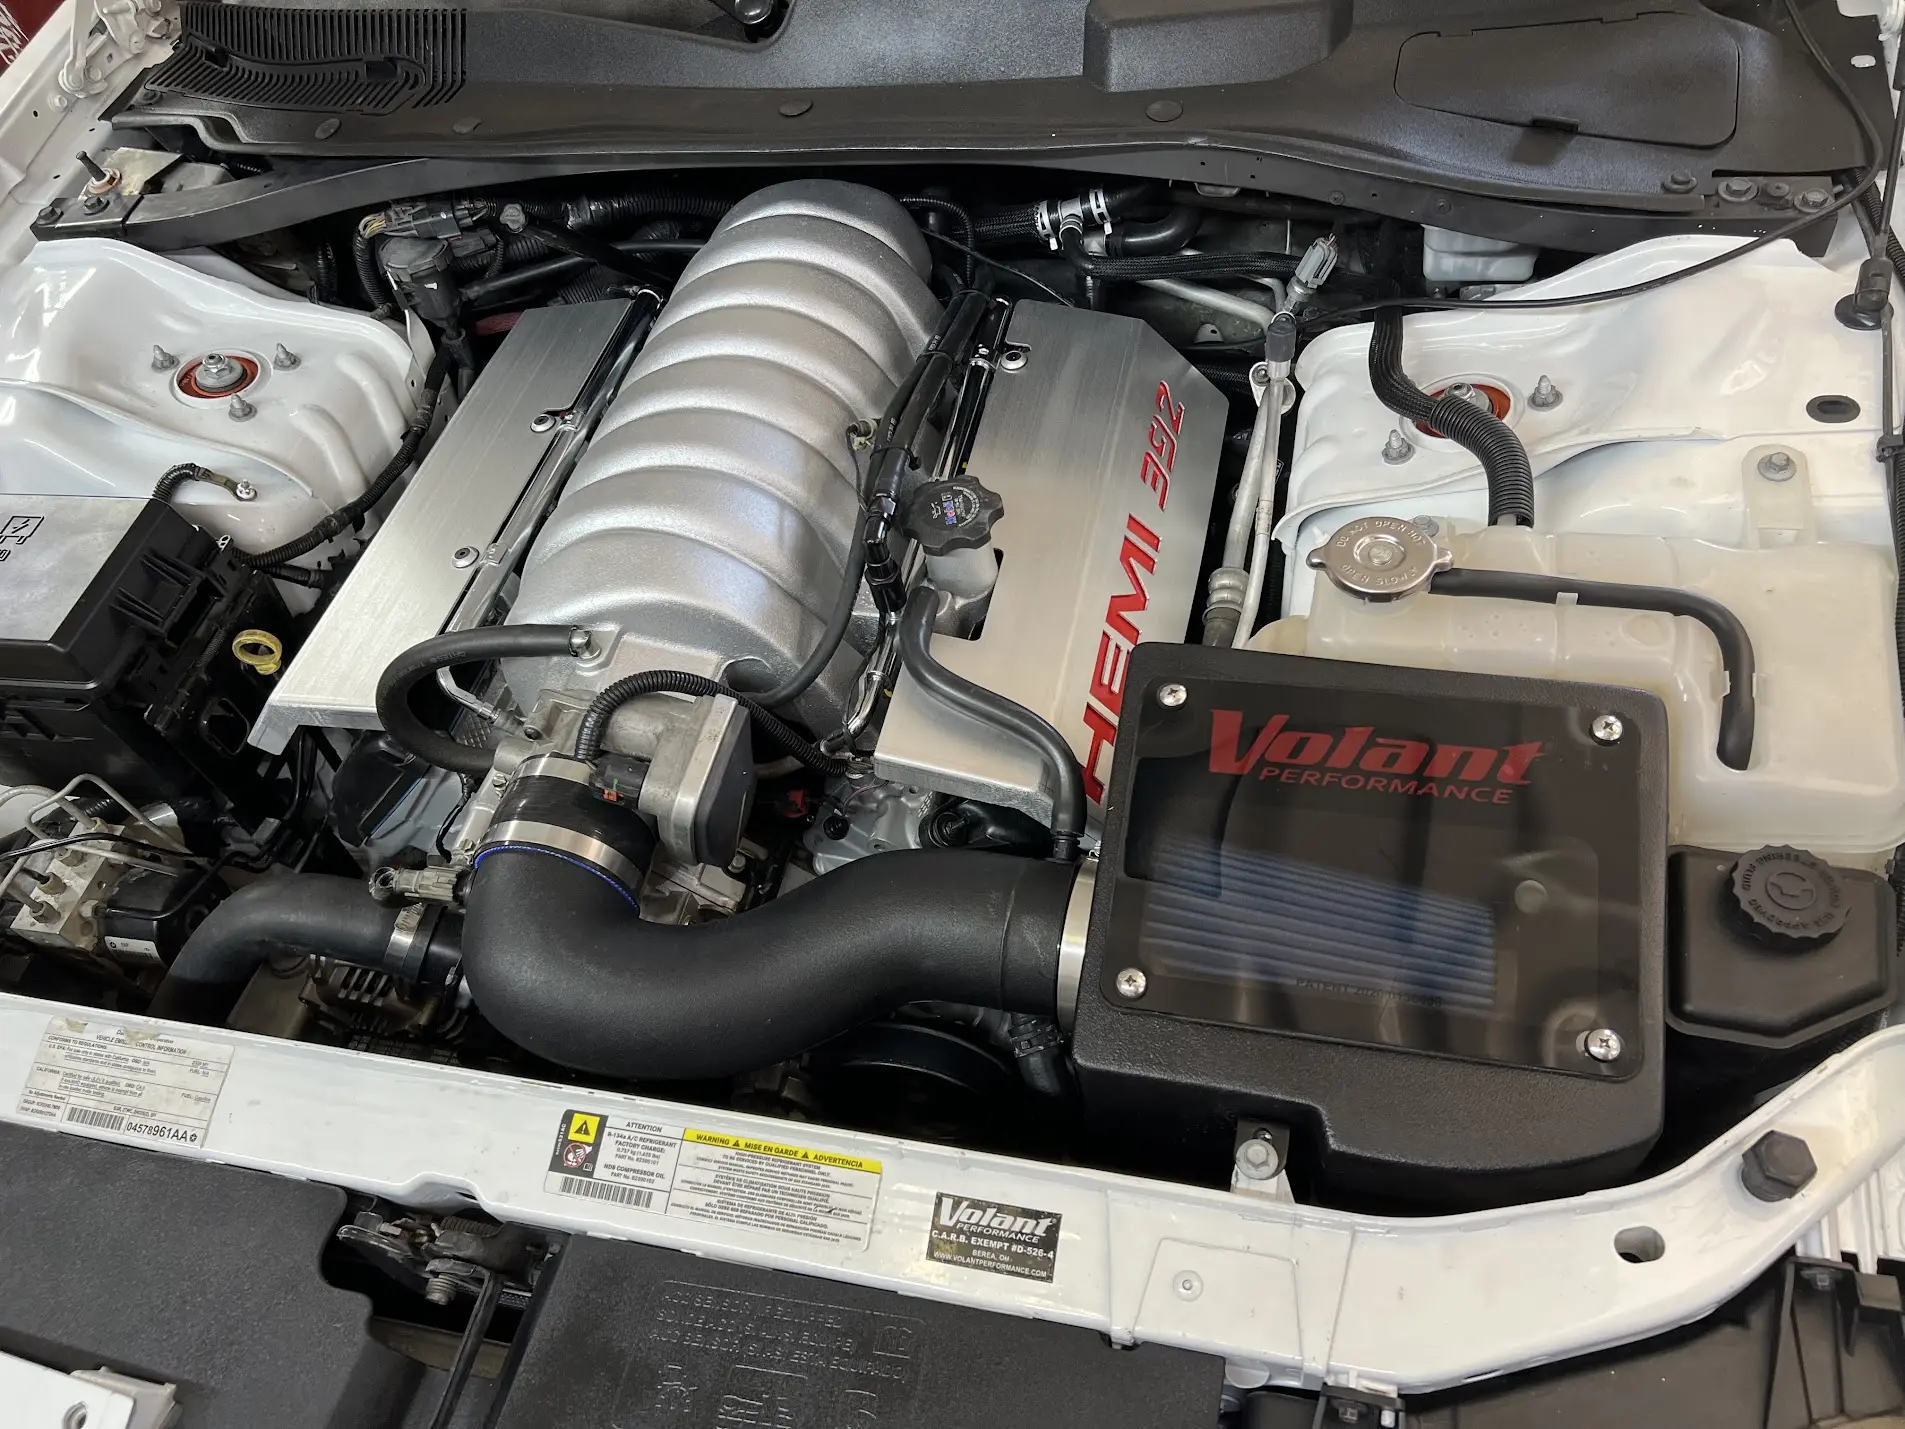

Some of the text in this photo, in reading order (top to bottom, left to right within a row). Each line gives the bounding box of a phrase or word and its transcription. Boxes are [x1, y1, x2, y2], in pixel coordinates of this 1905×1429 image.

[1336, 520, 1426, 547] DO NOT OPEN HOT
[1342, 564, 1370, 584] OPEN
[1082, 379, 1185, 807] HEMI 392
[1208, 709, 1548, 786] Volant
[1259, 767, 1514, 804] PERFORMANCE
[1296, 978, 1349, 992] PATENT
[135, 1041, 156, 1049] CONTROL
[156, 1045, 186, 1054] INFORMATION
[126, 1121, 188, 1142] 04578961AA
[625, 1122, 661, 1132] ATTENTION
[607, 1131, 626, 1139] R-134a
[639, 1136, 676, 1147] REFRIGERANT
[615, 1140, 639, 1148] FACTORY
[696, 1134, 729, 1145] WARNING
[744, 1142, 761, 1150] MISE
[774, 1147, 798, 1156] GARDE
[813, 1154, 863, 1168] ADVERTENCIA
[616, 1165, 654, 1177] COMPRESSOR
[939, 1197, 1053, 1237] Volant
[956, 1223, 1040, 1243] PERFORMANCE
[931, 1230, 1054, 1259] C.A.R.B. EXEMPT #D-526-4
[933, 1250, 1047, 1278] WWW.VOLANTPERFORMANCE.COM
[999, 1254, 1010, 1262] OH
